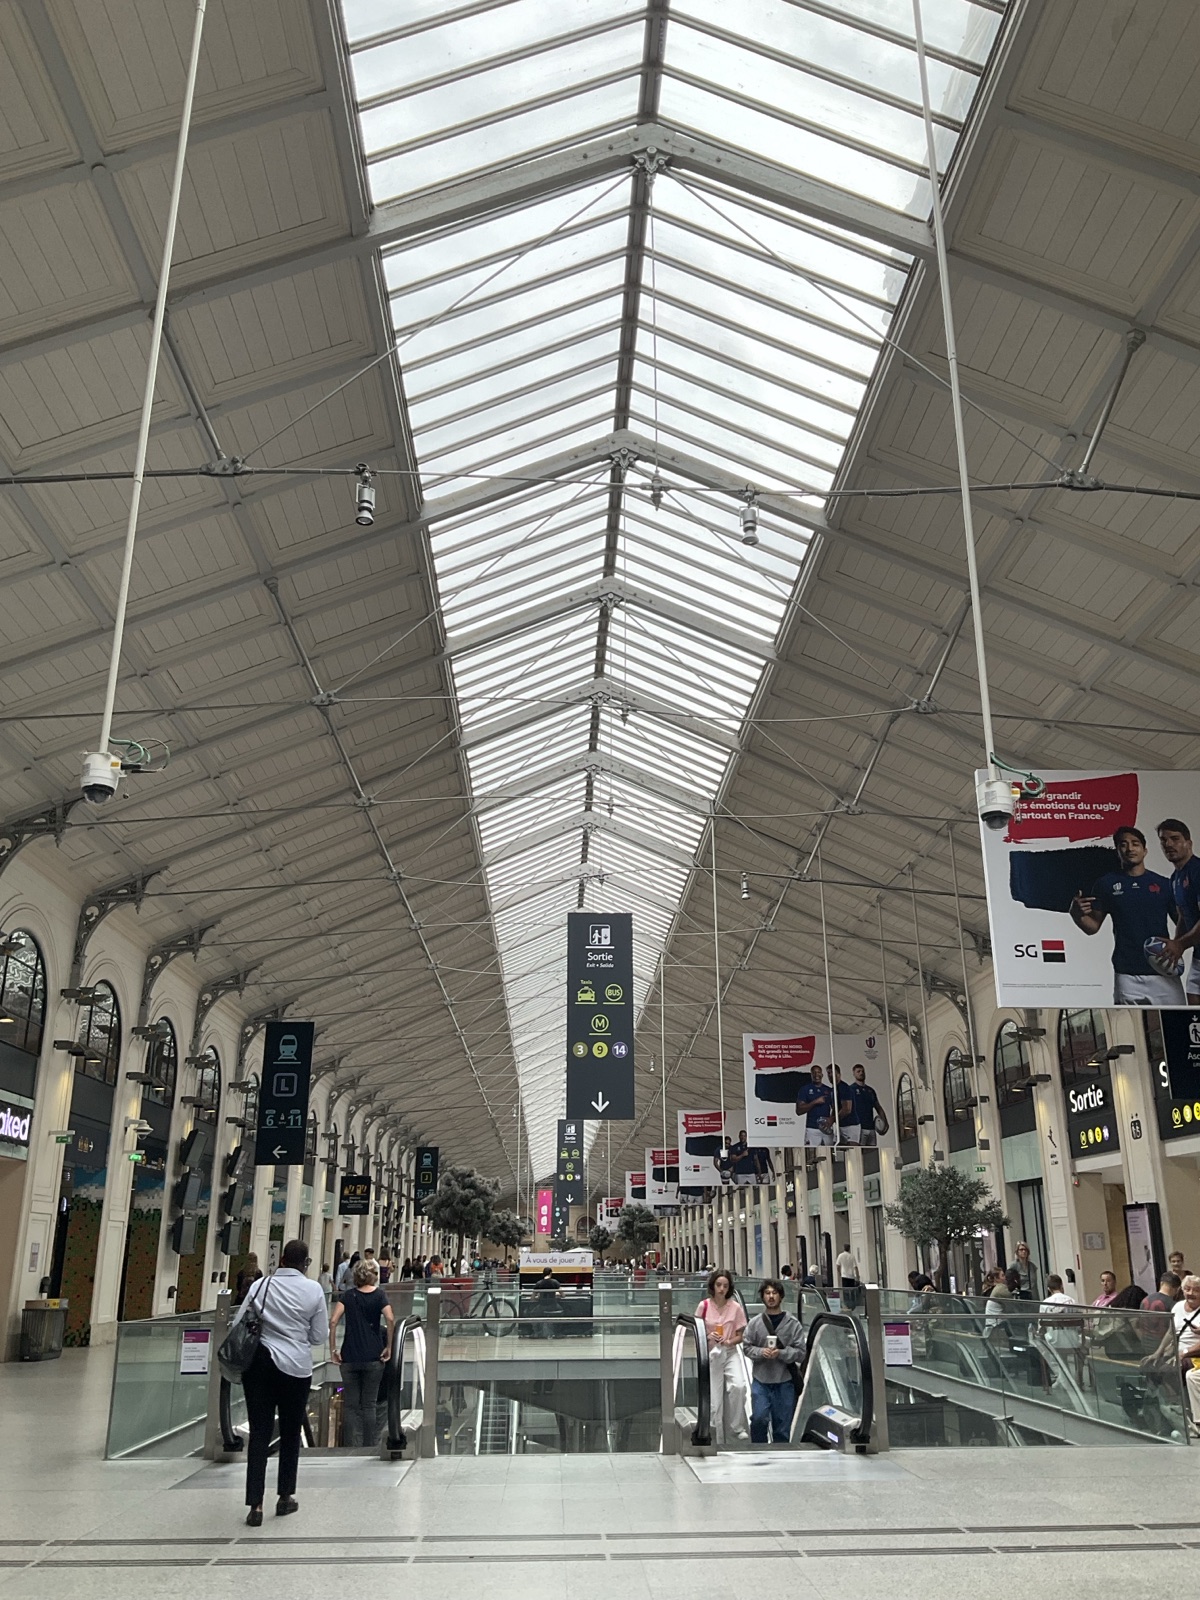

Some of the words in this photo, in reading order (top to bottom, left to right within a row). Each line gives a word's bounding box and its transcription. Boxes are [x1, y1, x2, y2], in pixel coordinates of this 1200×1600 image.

[1046, 792, 1082, 801] grandir
[1077, 802, 1091, 810] du
[1092, 802, 1121, 811] rugby
[1068, 812, 1104, 820] France.
[1014, 944, 1038, 958] SG
[587, 952, 613, 961] Sortie
[595, 1018, 605, 1028] M
[577, 1045, 584, 1055] 3
[596, 1045, 603, 1055] 9
[613, 1045, 626, 1055] 14
[281, 1078, 289, 1091] L
[1069, 1084, 1104, 1113] Sortie
[266, 1115, 274, 1126] 6
[288, 1115, 302, 1126] 11
[755, 1117, 766, 1125] SG
[548, 1256, 558, 1264] de
[558, 1256, 575, 1265] jouer
